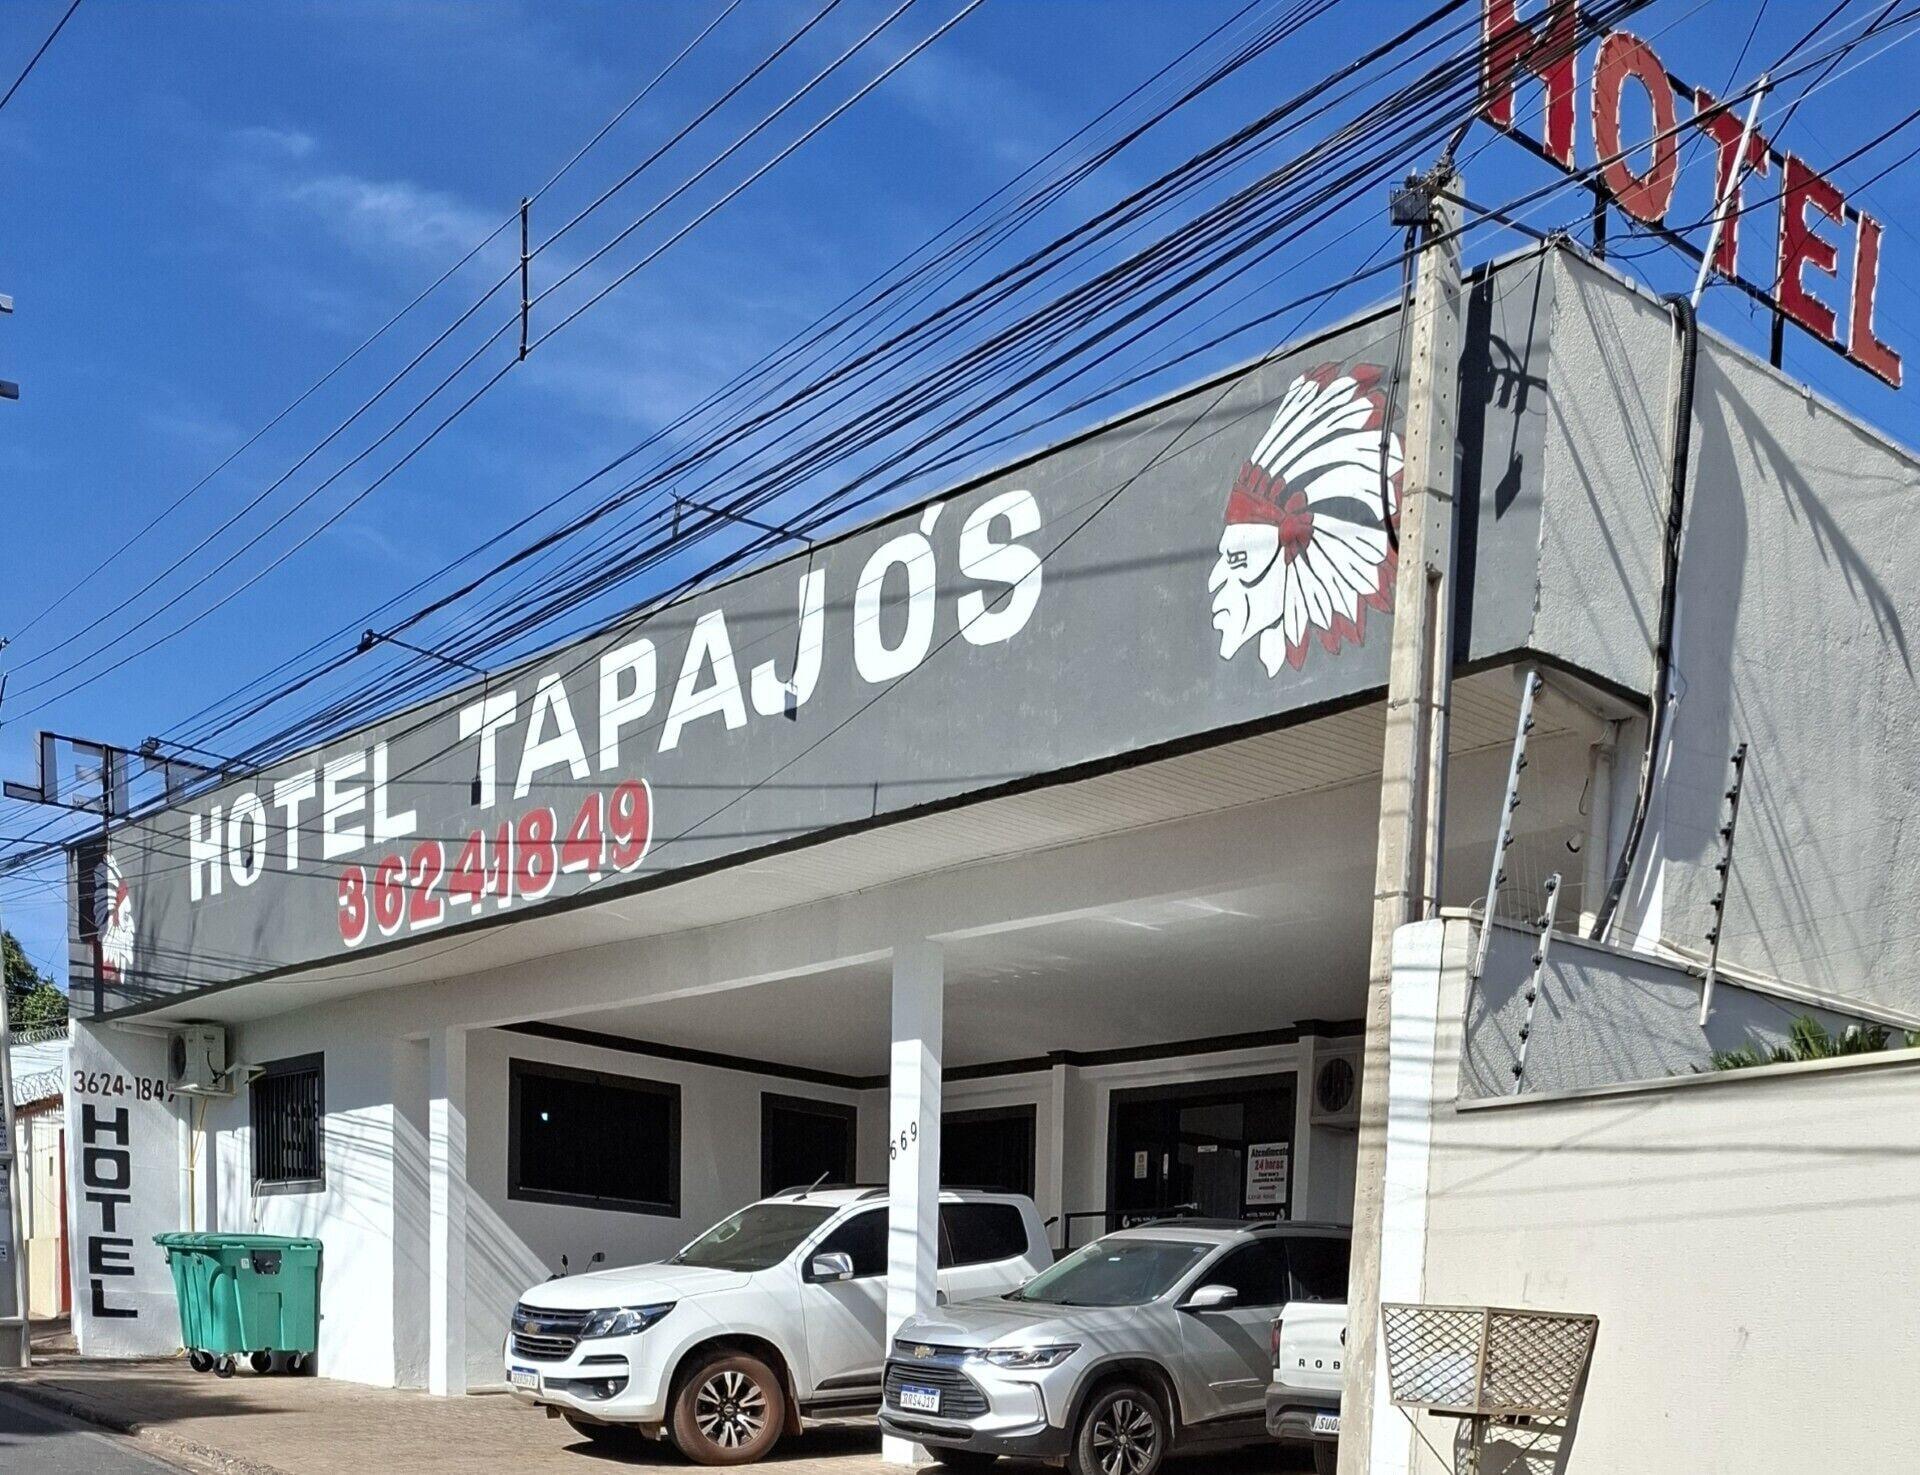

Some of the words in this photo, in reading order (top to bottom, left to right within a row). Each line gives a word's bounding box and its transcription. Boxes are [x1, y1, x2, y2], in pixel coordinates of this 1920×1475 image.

[1484, 0, 1903, 389] HOTEL
[189, 739, 418, 902] HOTEL
[338, 778, 653, 947] 36241849
[81, 1103, 139, 1319] HOTEL
[889, 1121, 918, 1161] 669
[1298, 1358, 1341, 1370] ROB
